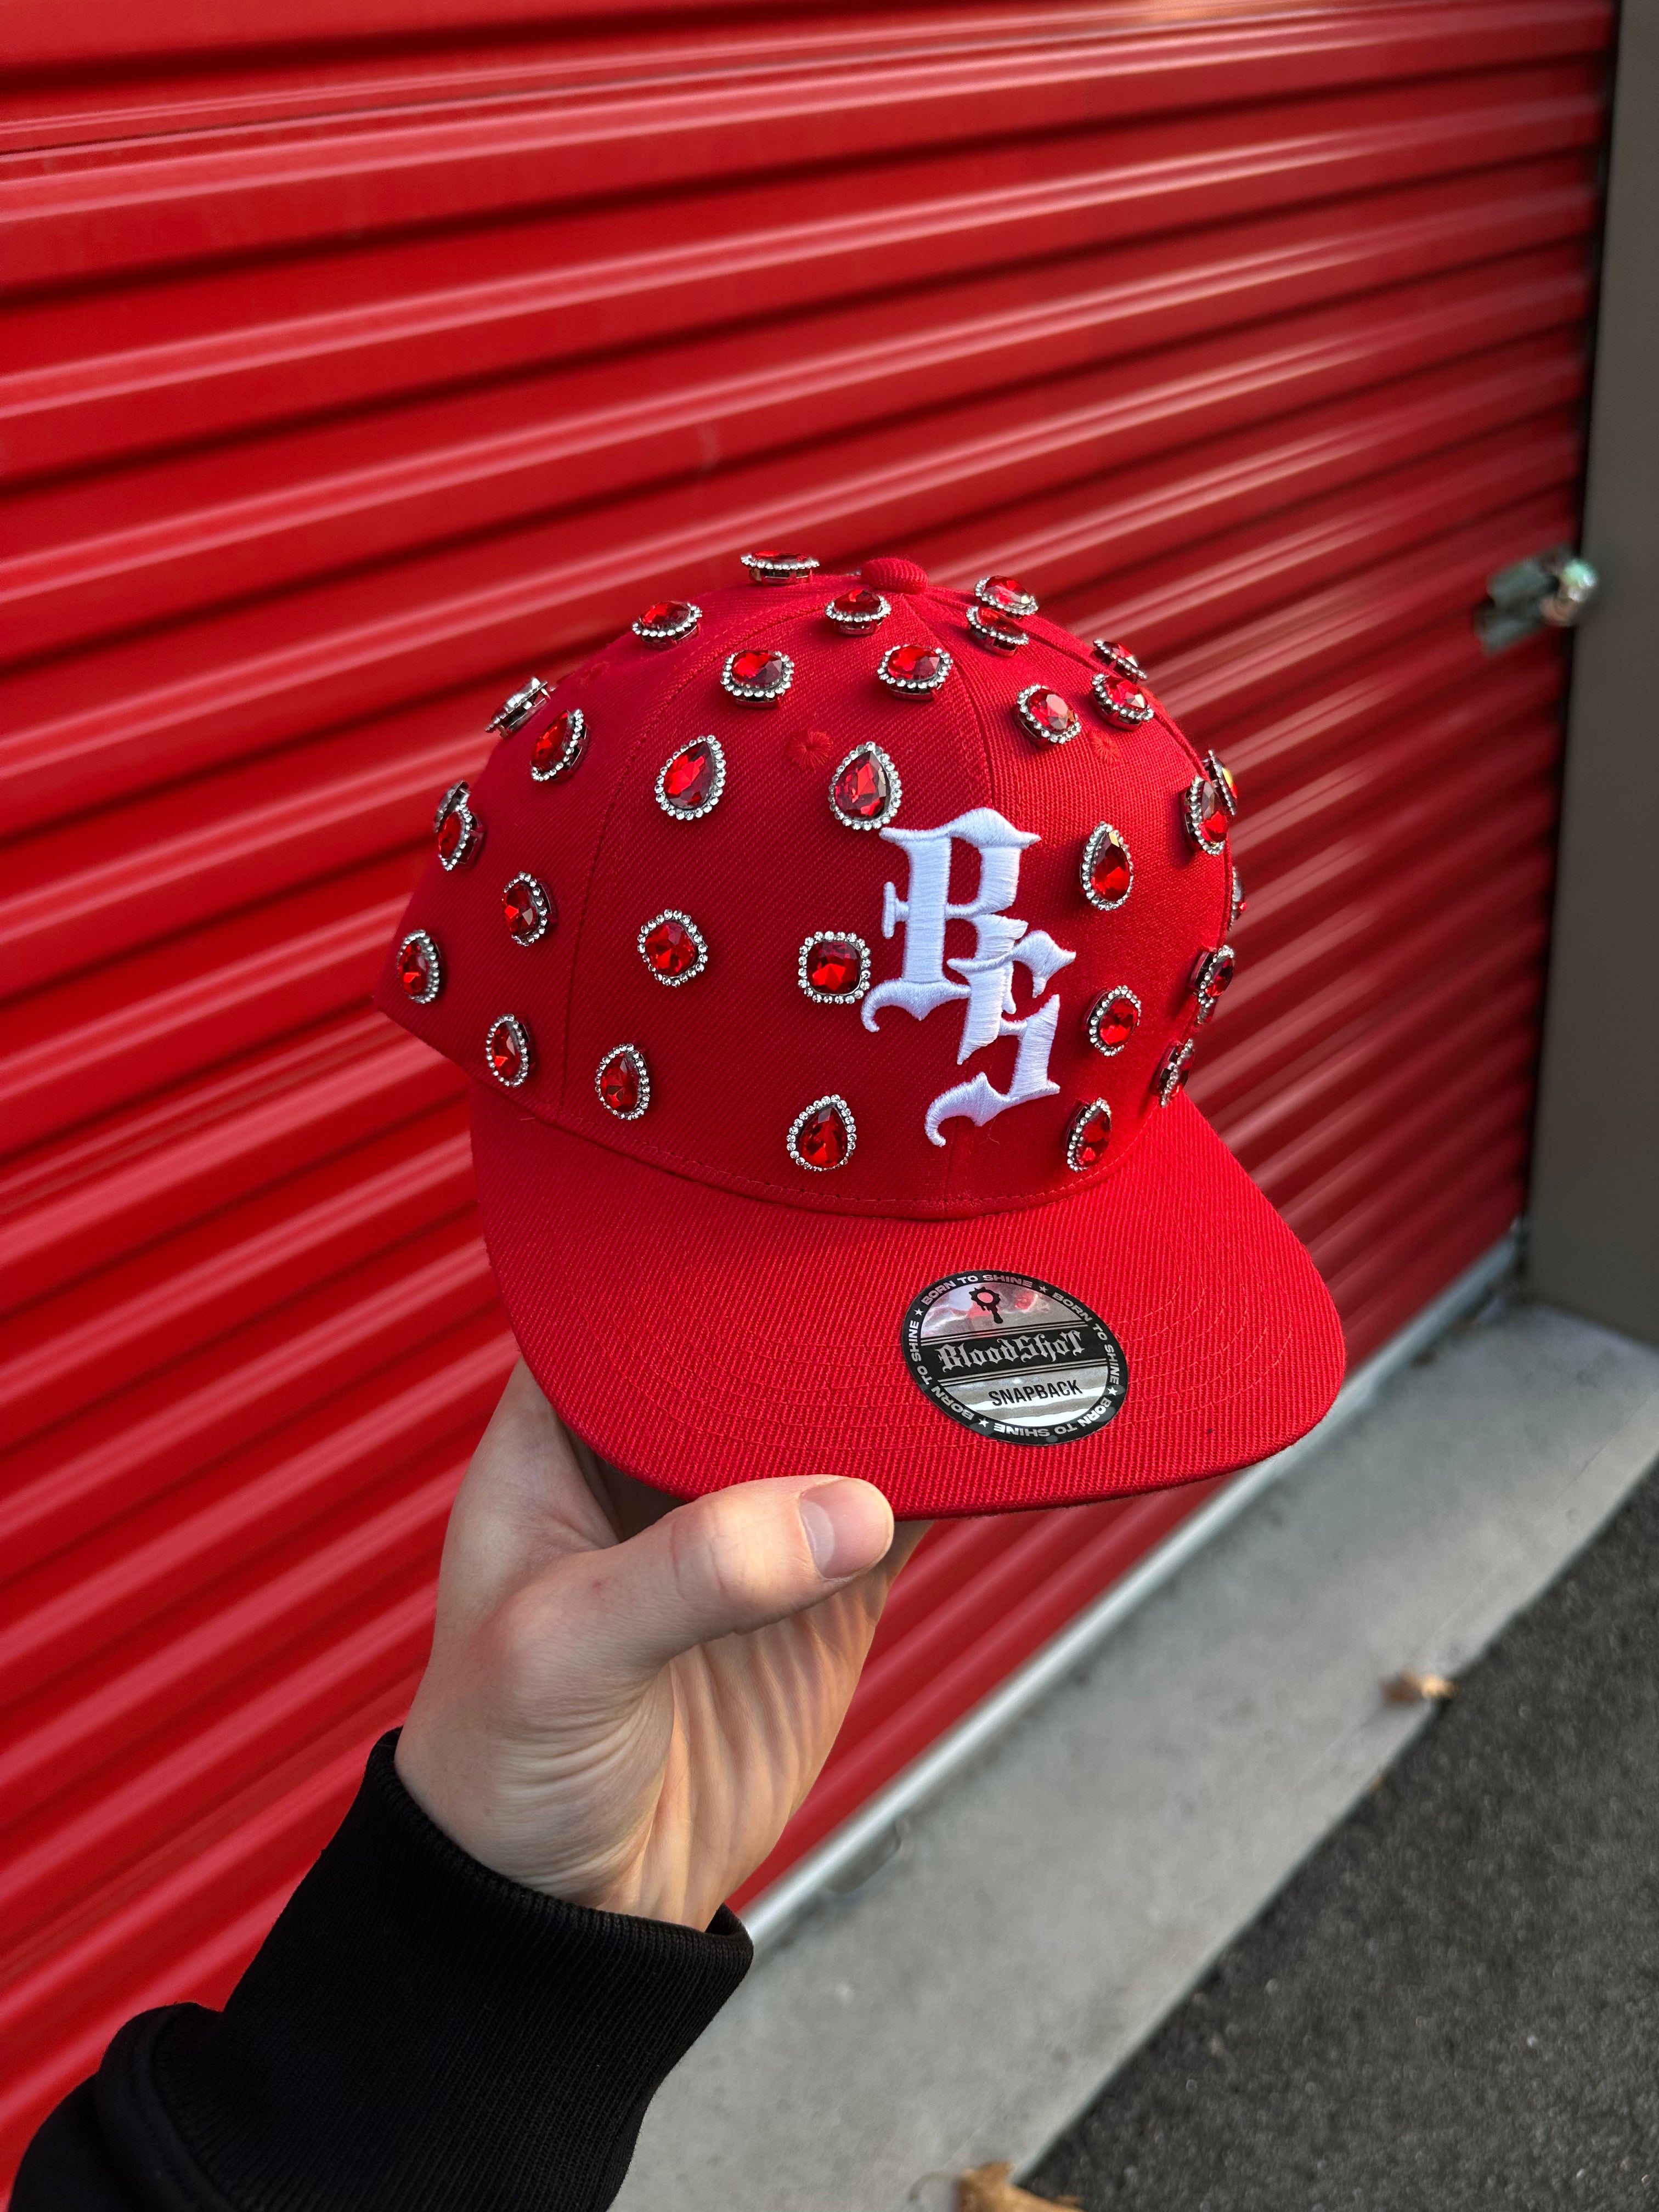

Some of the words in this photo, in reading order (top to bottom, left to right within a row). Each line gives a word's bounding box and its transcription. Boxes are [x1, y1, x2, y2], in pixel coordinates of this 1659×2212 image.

[922, 1280, 956, 1306] BORN
[957, 1274, 978, 1284] TO
[983, 1274, 1033, 1288] SHINE
[909, 1319, 922, 1362] SHINE
[1052, 1292, 1091, 1321] BORN
[1092, 1324, 1108, 1340] TO
[1104, 1345, 1119, 1385] SHINE
[917, 1366, 932, 1385] TO
[931, 1386, 974, 1420] BORN
[989, 1380, 1083, 1407] SNAPBACK
[1079, 1397, 1112, 1426] BORN
[994, 1423, 1049, 1437] SHINE
[1054, 1425, 1077, 1435] TO
